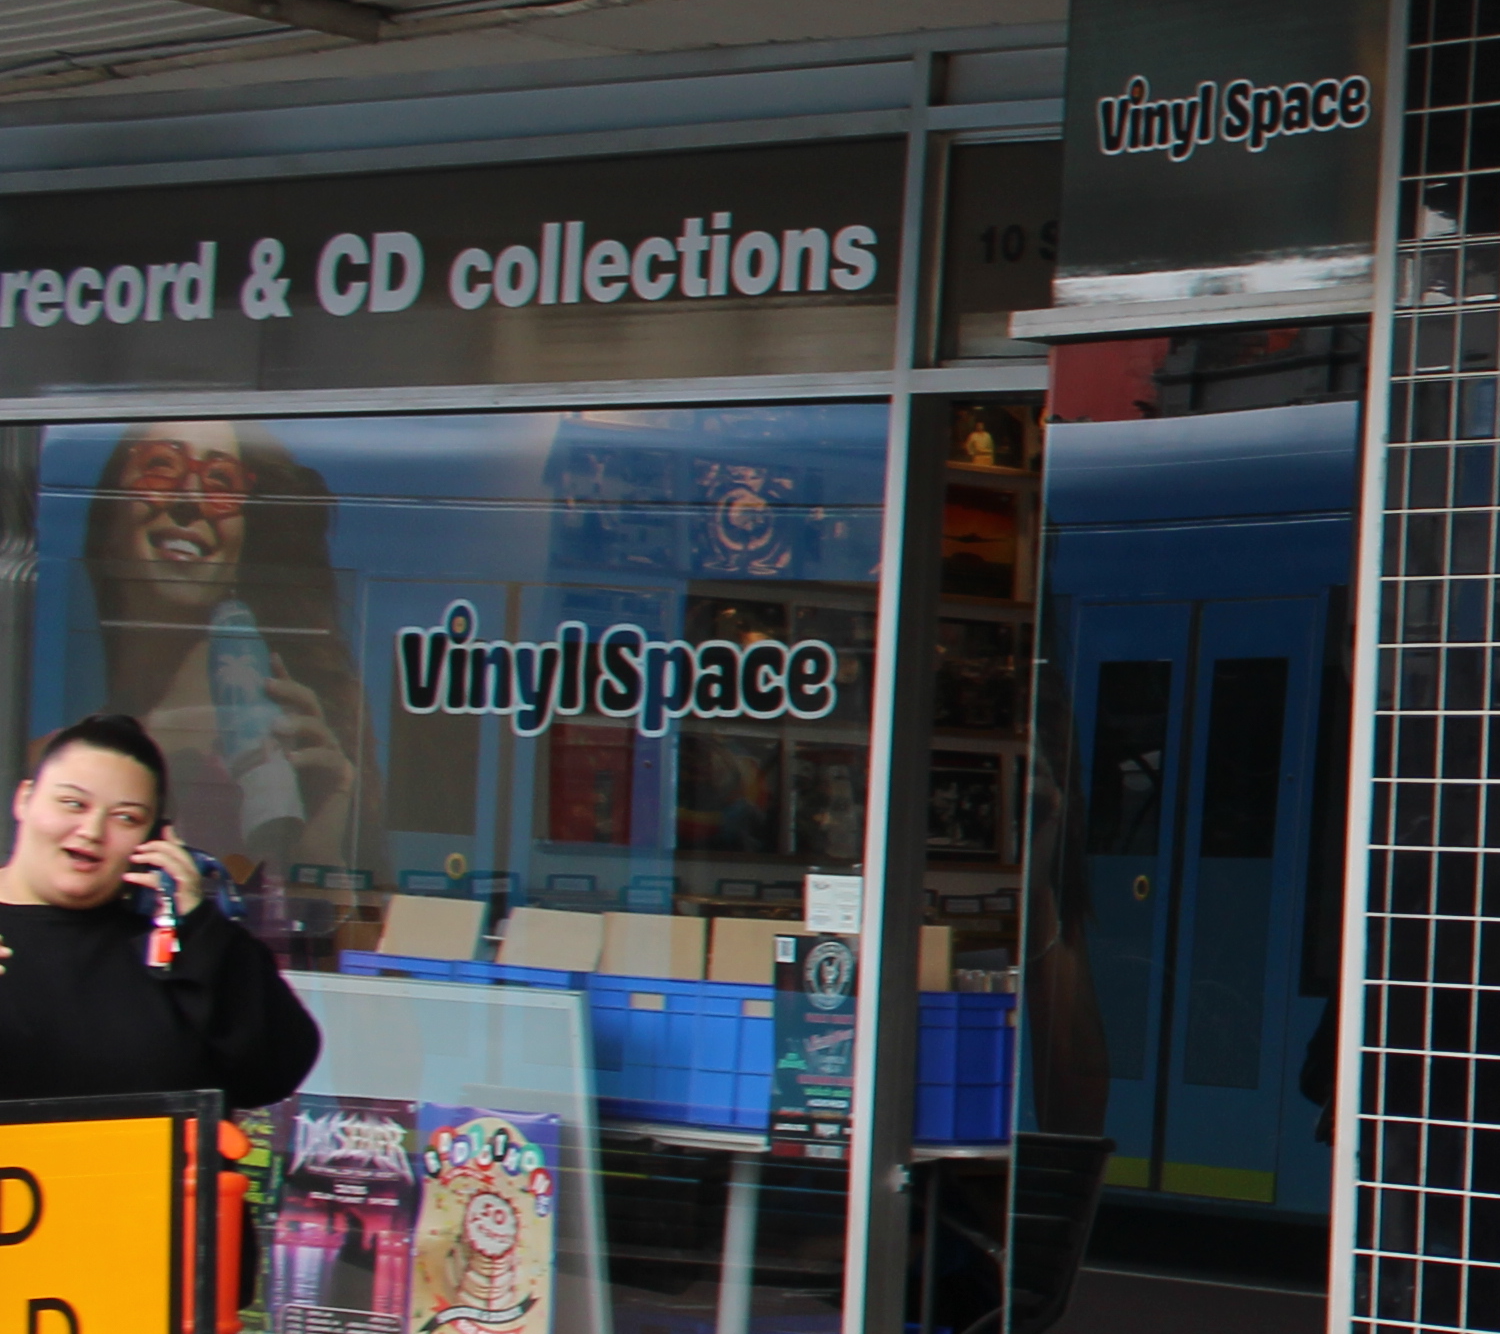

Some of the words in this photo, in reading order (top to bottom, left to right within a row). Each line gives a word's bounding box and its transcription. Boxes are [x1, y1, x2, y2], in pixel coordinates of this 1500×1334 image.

[1097, 76, 1214, 161] Vinyl
[1222, 73, 1370, 152] Space
[0, 240, 218, 329] record
[241, 238, 292, 321] &
[316, 229, 424, 317] CD
[450, 210, 878, 310] collections
[980, 223, 1025, 264] 10
[397, 598, 588, 737] Vinyl
[595, 621, 838, 738] Space
